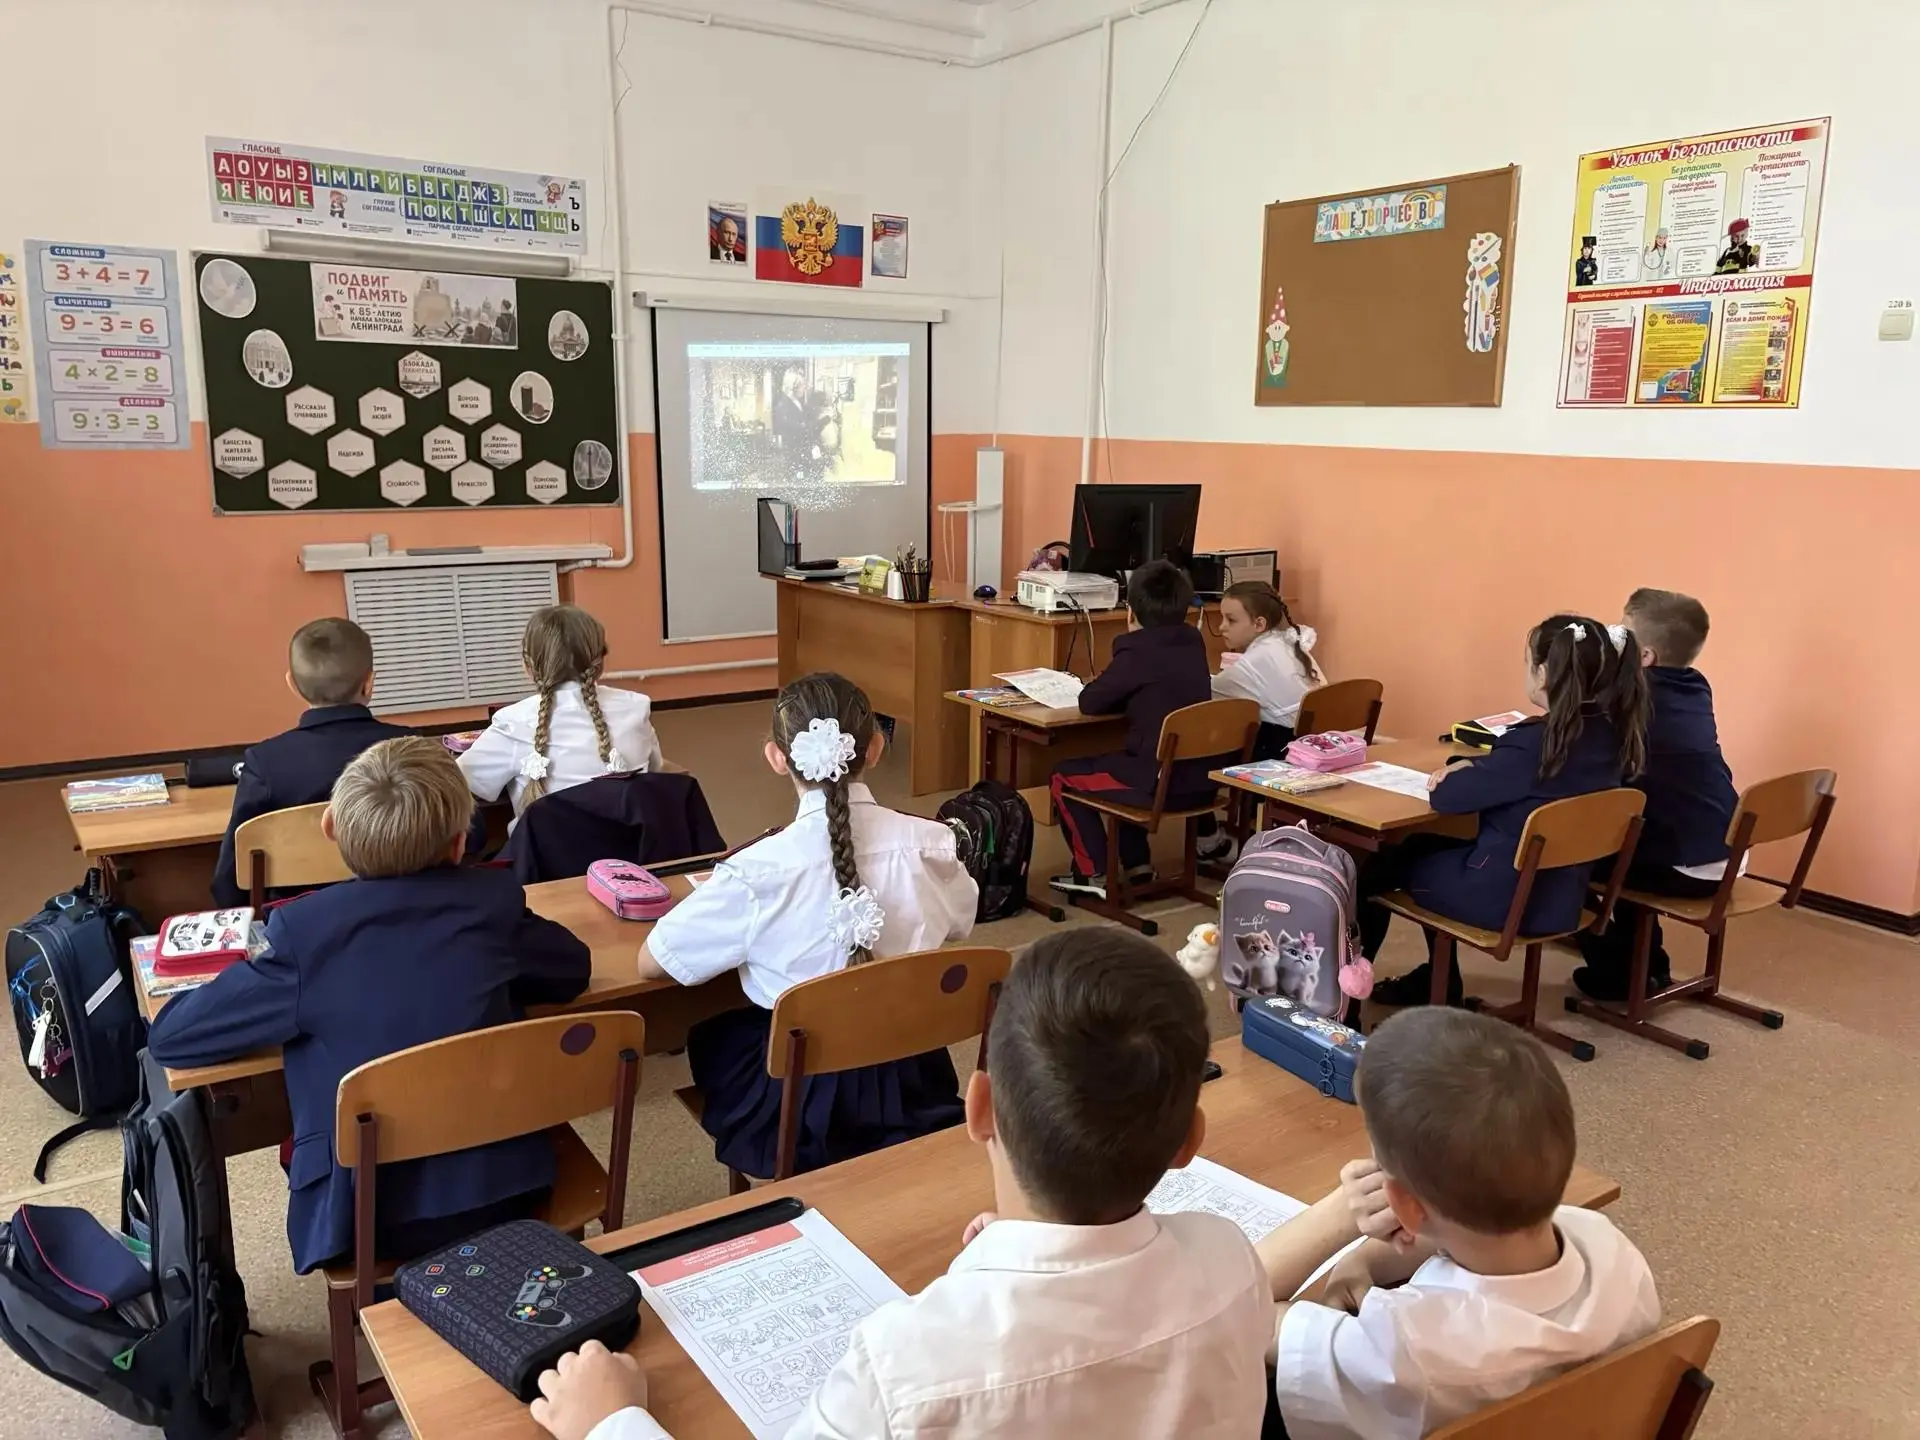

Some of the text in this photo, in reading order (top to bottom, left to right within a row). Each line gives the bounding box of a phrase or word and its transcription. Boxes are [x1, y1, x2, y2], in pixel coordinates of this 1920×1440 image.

[242, 143, 281, 154] ГЛАСНЫЕ
[1608, 130, 1795, 168] Уголок Безопасности
[423, 165, 466, 176] СОГЛАСНЫЕ
[1325, 198, 1435, 231] НАШЕ ТВОРЧЕСТВО
[55, 248, 100, 257] СЛОЖЕНИЕ
[56, 264, 70, 280] 3
[96, 267, 111, 283] 4
[136, 270, 149, 285] 7
[328, 272, 389, 288] ПОДВИГ
[1678, 274, 1785, 296] Информация
[58, 298, 108, 307] ВЫЧИТАНИЕ
[347, 288, 407, 303] ПАМЯТЬ
[60, 314, 75, 330] 9
[100, 316, 114, 332] 3
[140, 319, 154, 334] 6
[351, 323, 404, 332] ЛЕНИНГРАДА
[106, 350, 156, 358] УМНОЖЕНИЕ
[65, 364, 80, 379] 4
[105, 365, 119, 381] 2
[144, 367, 158, 383] 8
[124, 398, 160, 406] ДЕЛЕНИЕ
[73, 413, 87, 429] 9
[107, 414, 120, 429] 3
[146, 415, 159, 430] 3
